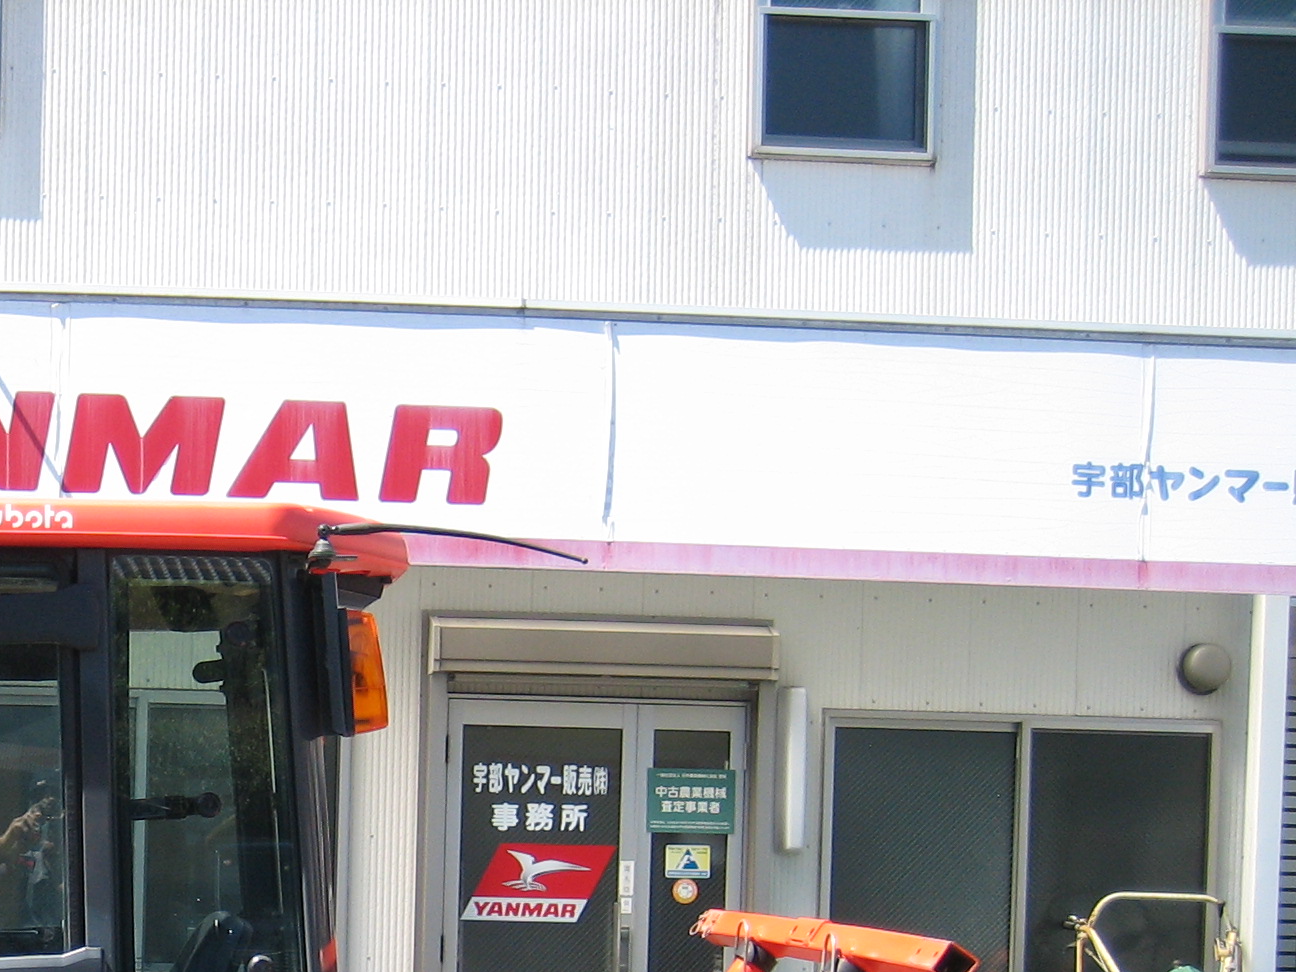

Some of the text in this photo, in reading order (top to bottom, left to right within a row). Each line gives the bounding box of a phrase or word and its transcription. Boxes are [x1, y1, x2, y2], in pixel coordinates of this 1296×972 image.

[1072, 461, 1296, 505] 宇部ヤンマー
[491, 802, 589, 833] 事務所
[473, 901, 577, 919] YANMAR
